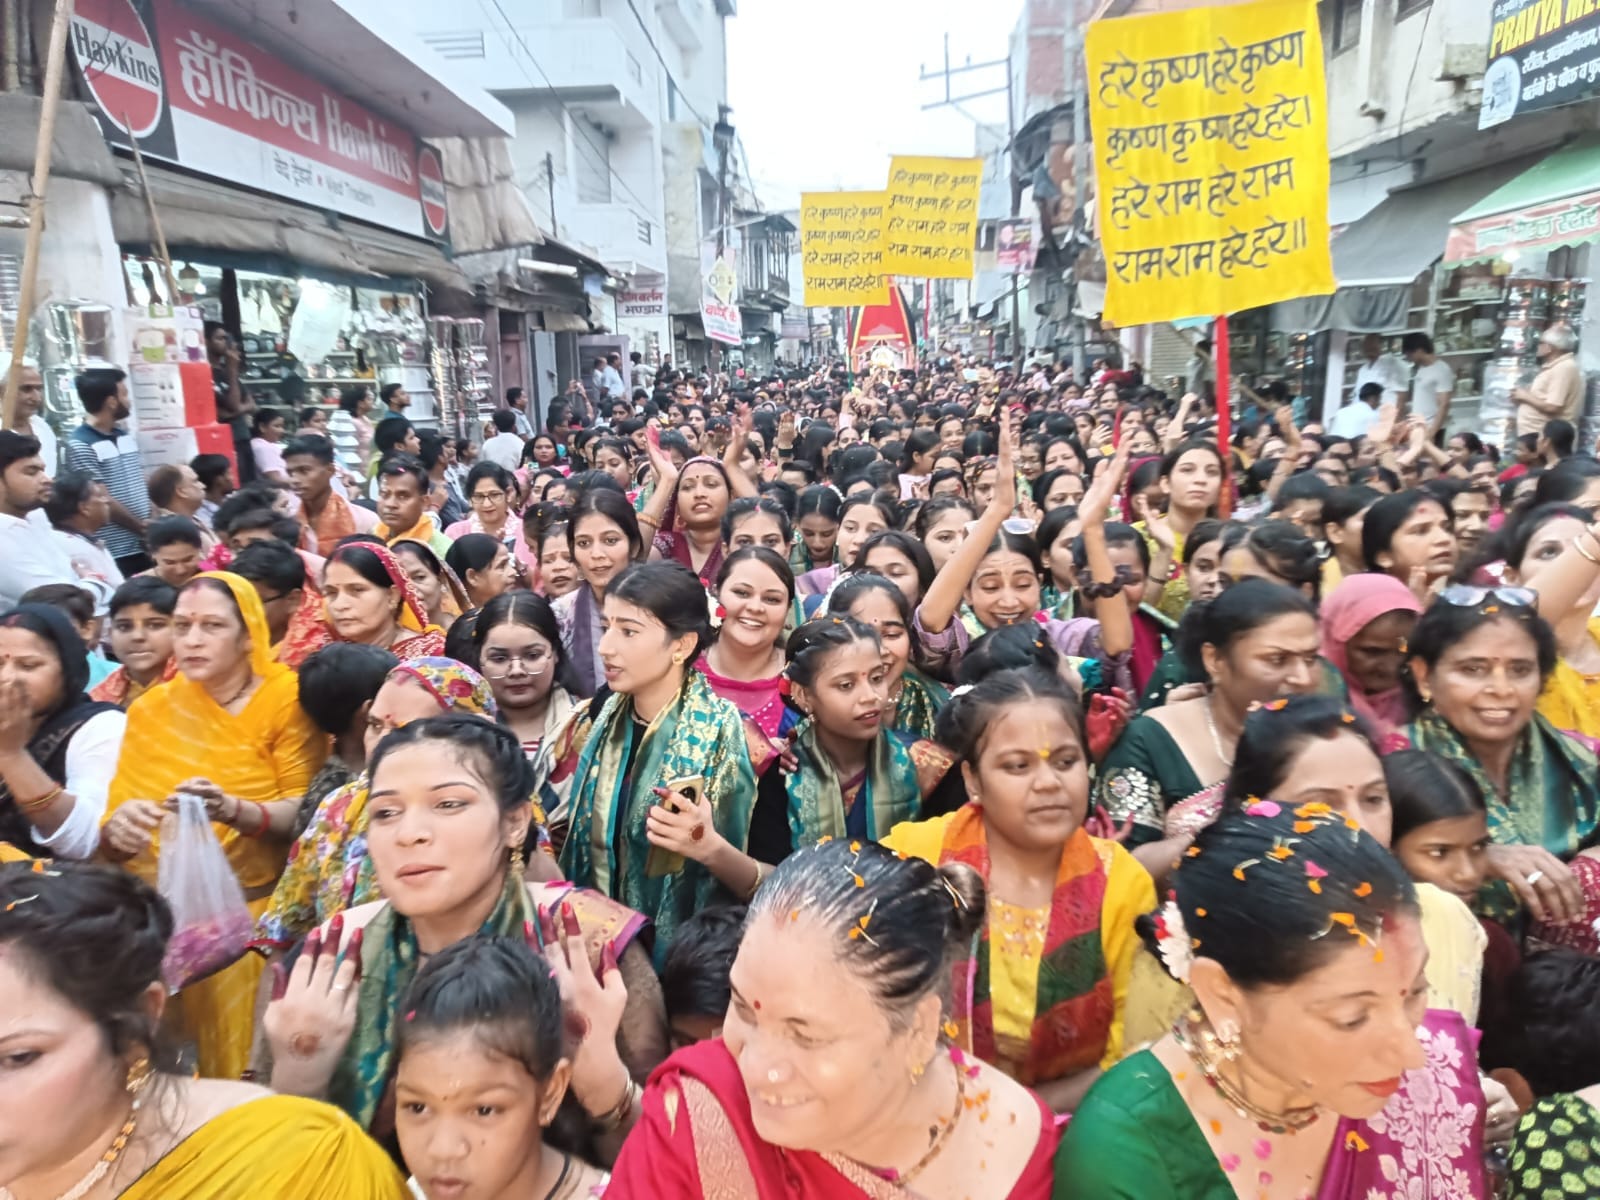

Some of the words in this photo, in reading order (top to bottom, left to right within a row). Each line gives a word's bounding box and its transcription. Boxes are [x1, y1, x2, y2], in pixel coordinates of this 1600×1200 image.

[73, 21, 159, 87] Hawkins
[1489, 0, 1562, 59] PRAVYA
[1099, 50, 1138, 108] हरे
[1141, 52, 1210, 108] कृष्ण
[1211, 37, 1238, 95] हरे
[1240, 30, 1305, 94] कृष्ण
[176, 30, 320, 145] हॉकिन्स
[323, 93, 413, 185] Hawkins
[1106, 123, 1167, 170] कृष्ण
[1172, 115, 1232, 163] कृष्ण
[1230, 102, 1265, 150] हरे
[1112, 176, 1150, 229] हरे
[1154, 178, 1202, 217] राम
[1207, 164, 1240, 217] हरे
[1241, 157, 1295, 200] राम
[1113, 247, 1164, 283] राम
[1166, 240, 1216, 277] राम
[1219, 226, 1251, 279] हरे
[625, 304, 663, 314] भण्डार
